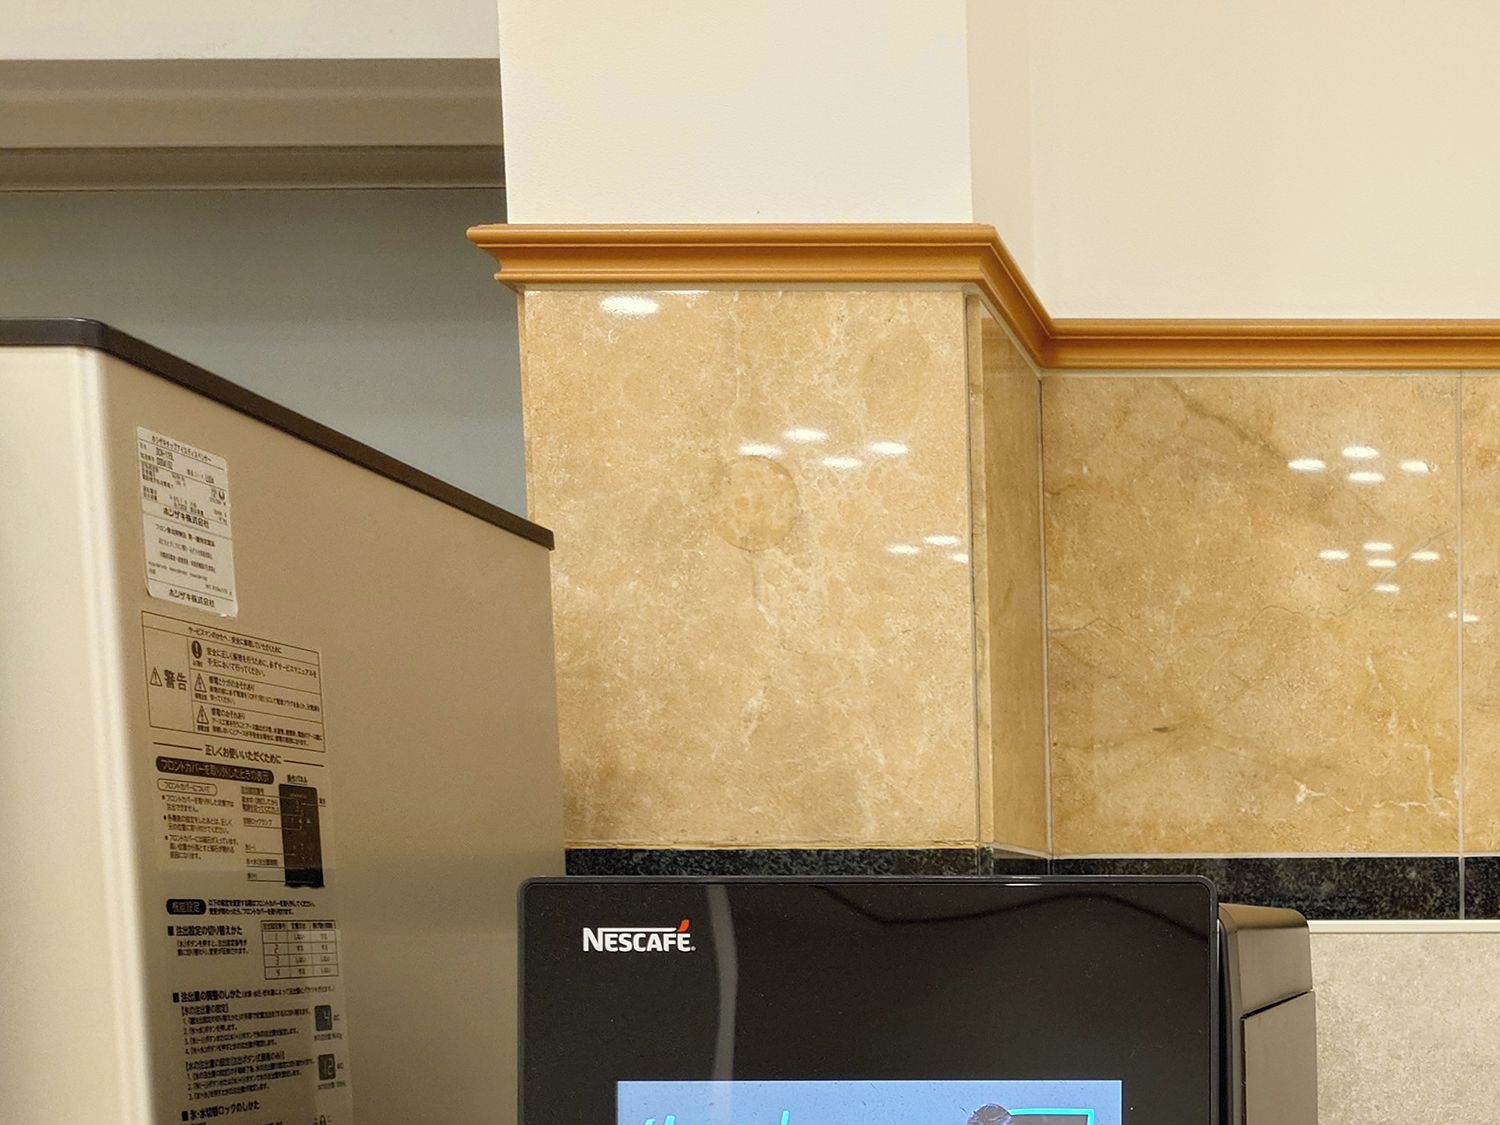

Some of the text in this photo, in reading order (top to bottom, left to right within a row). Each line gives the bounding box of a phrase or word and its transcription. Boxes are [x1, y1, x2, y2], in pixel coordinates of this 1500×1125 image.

[162, 506, 209, 528] ホシザキ株式会社
[168, 587, 214, 608] ホシザキ株式会社
[163, 668, 188, 692] 警告
[204, 743, 282, 766] 正しくお使いいただくために
